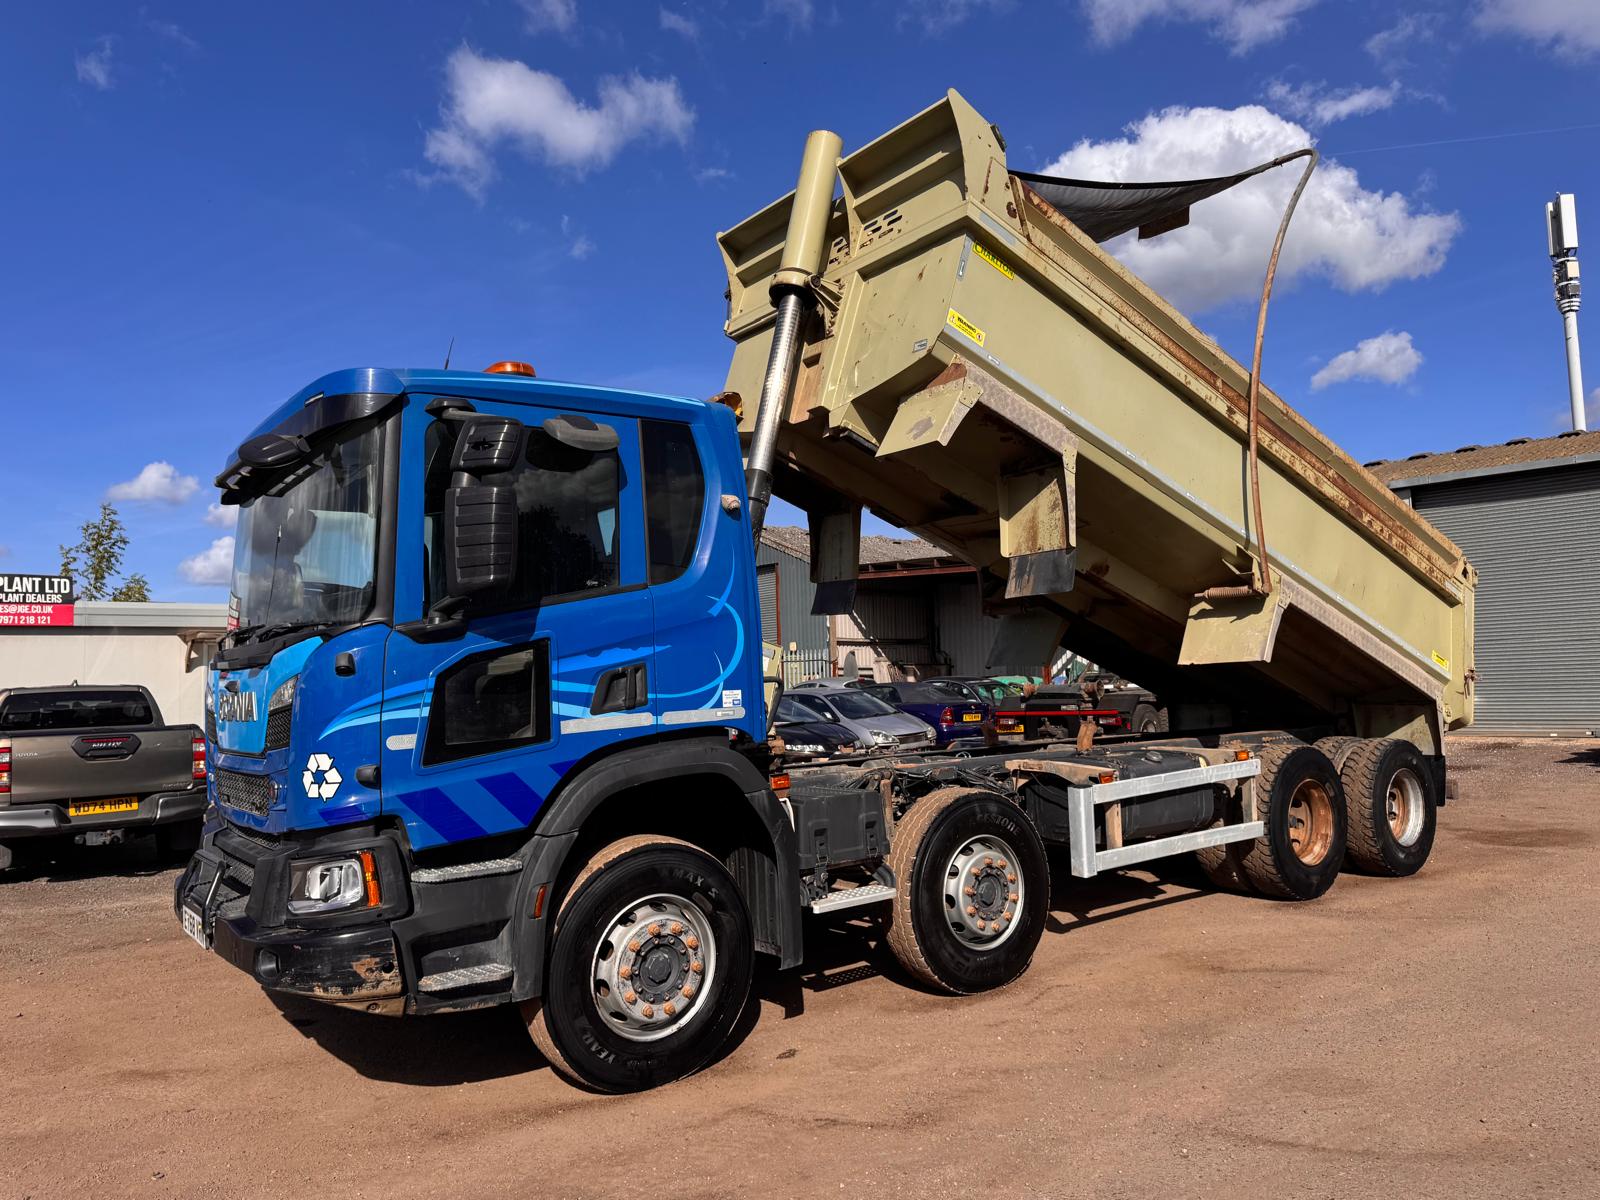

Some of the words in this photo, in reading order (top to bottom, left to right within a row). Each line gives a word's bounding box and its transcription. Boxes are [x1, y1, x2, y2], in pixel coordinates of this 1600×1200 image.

[45, 577, 70, 594] LTD
[25, 593, 63, 604] DEALERS
[20, 615, 35, 624] 218
[37, 615, 51, 624] 121
[74, 801, 106, 814] WD74
[109, 798, 133, 811] HPN
